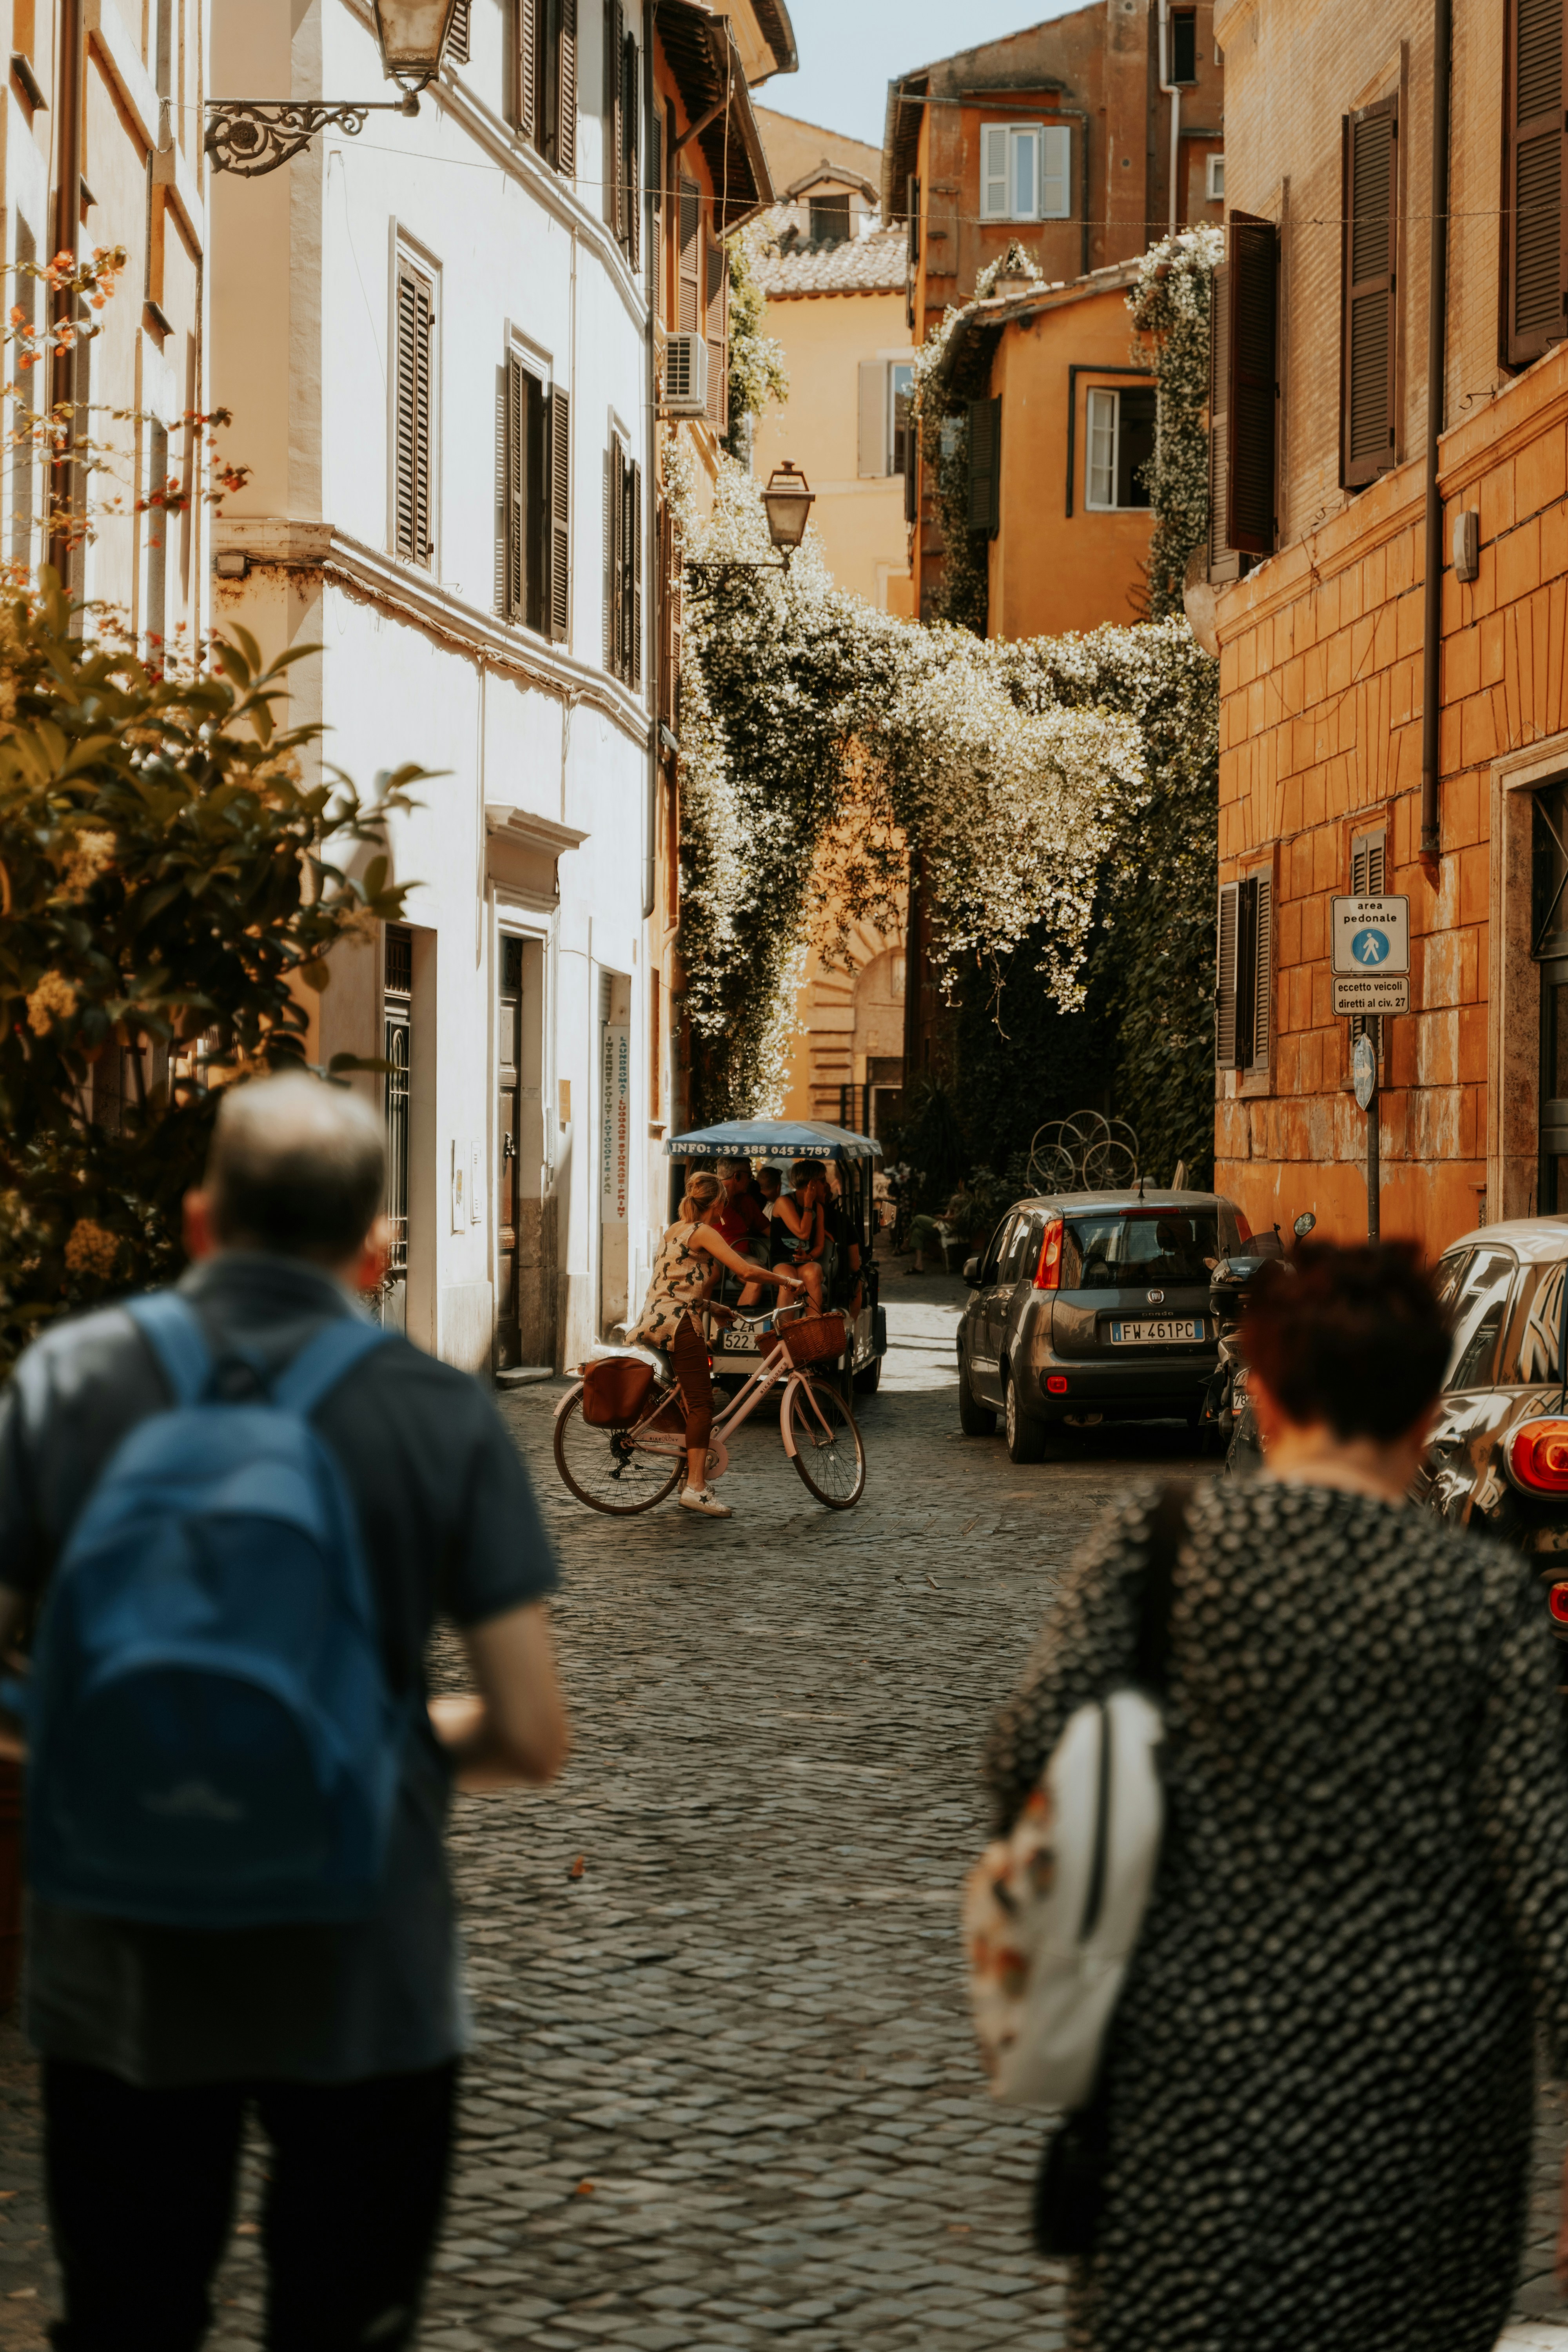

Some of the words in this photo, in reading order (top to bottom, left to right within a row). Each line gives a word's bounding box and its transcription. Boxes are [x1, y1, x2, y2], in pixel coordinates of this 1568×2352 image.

[1344, 913, 1397, 924] pedonale
[1338, 983, 1371, 992] eccetto
[1374, 982, 1402, 991] veicoli
[1339, 999, 1365, 1008] diretti
[1367, 998, 1375, 1007] al
[1378, 998, 1392, 1007] civ.
[1395, 998, 1405, 1007] 27
[618, 1036, 627, 1095] LAUNDROMAT
[604, 1085, 613, 1114] POINT
[618, 1100, 626, 1140] LUGGAGE
[617, 1143, 626, 1184] STORAGE
[671, 1143, 711, 1153] INFO:
[716, 1145, 739, 1155] +39
[743, 1145, 767, 1155] 388
[771, 1146, 795, 1156] 045
[799, 1146, 830, 1156] 1789
[617, 1189, 625, 1218] PRINT
[1123, 1324, 1141, 1339] FW
[1147, 1322, 1194, 1338] 461PC
[760, 1366, 783, 1394] BIKEOLOGY
